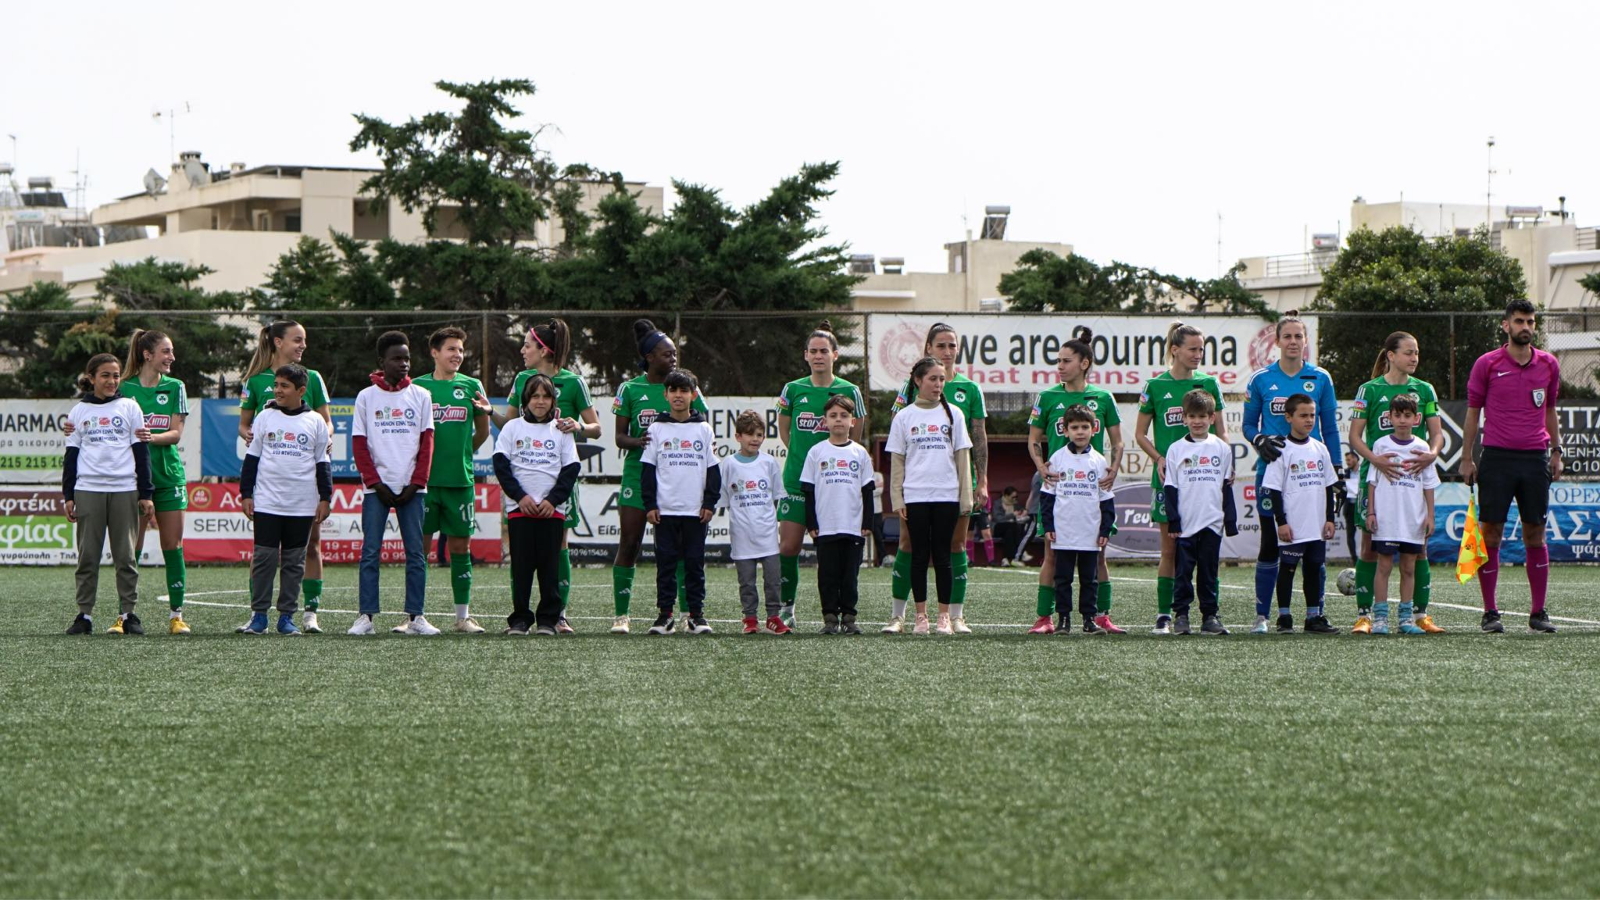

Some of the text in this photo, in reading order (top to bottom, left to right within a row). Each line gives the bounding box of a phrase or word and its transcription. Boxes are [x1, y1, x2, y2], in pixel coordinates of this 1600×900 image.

[1009, 334, 1060, 366] are
[0, 456, 21, 468] 215
[26, 456, 47, 468] 215
